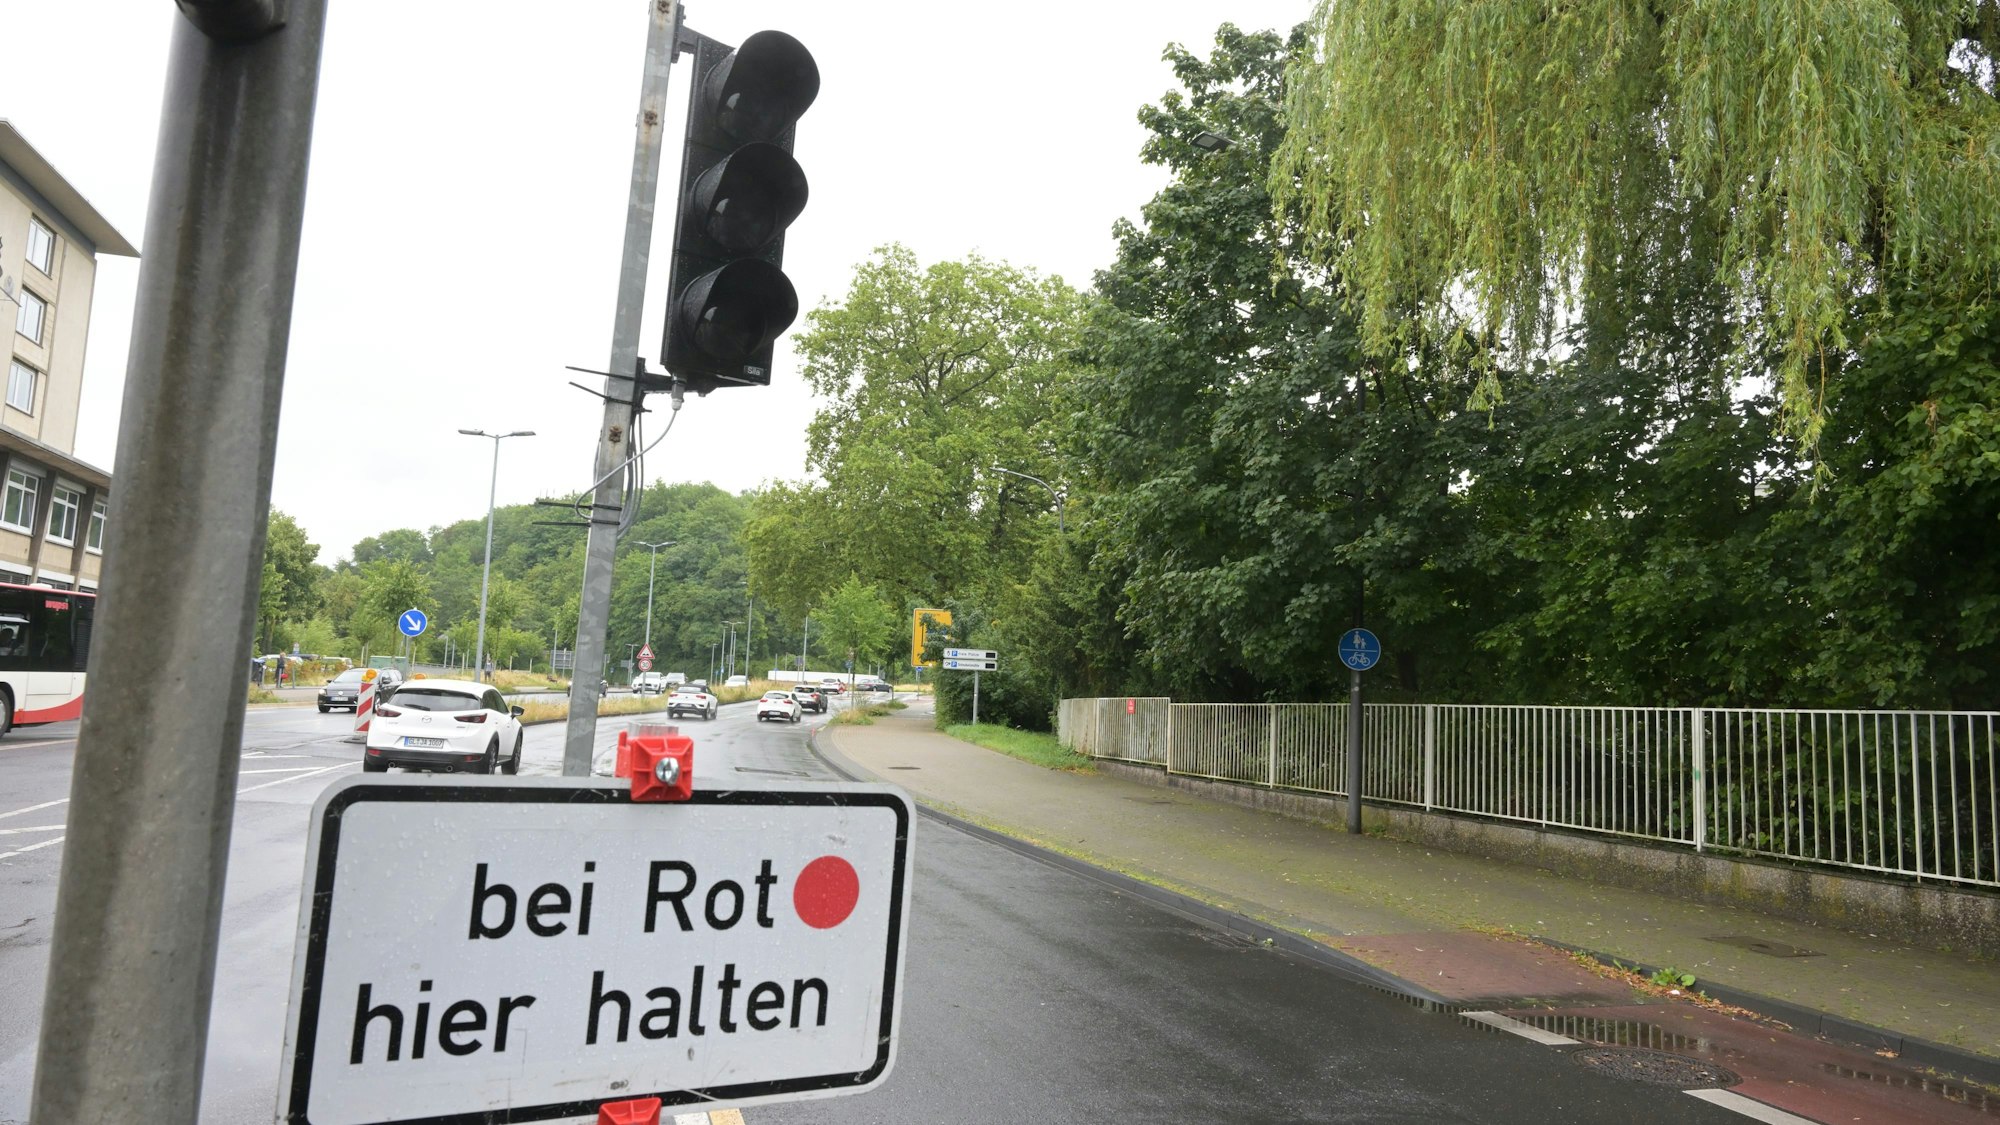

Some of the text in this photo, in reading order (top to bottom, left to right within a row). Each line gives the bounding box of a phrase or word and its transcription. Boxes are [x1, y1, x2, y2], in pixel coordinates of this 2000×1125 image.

[469, 859, 779, 940] bei Rot
[349, 963, 830, 1065] hier halten
